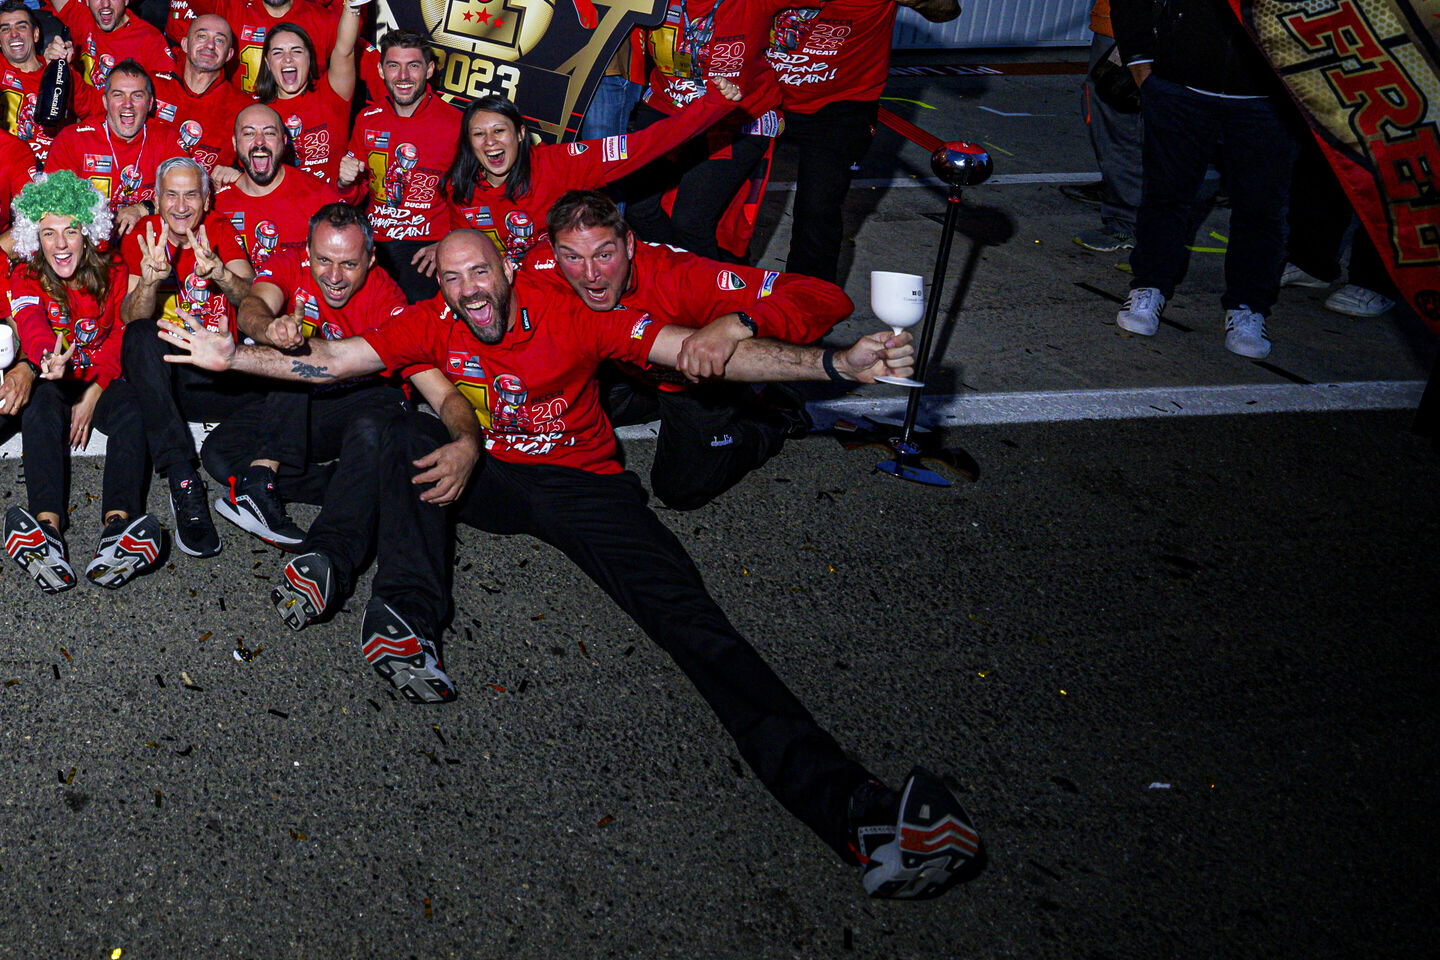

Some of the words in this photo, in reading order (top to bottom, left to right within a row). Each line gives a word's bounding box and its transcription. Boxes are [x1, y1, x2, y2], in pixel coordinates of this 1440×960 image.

[811, 23, 852, 38] 20
[712, 41, 746, 59] 20
[805, 36, 846, 50] 23
[802, 48, 838, 56] DUCATI
[709, 56, 745, 72] 23
[779, 67, 839, 86] AGAIN!
[51, 87, 63, 117] Castaldi
[304, 130, 330, 148] 20
[304, 144, 330, 161] 23
[304, 157, 329, 166] DUCATI
[411, 172, 440, 189] 20
[406, 186, 436, 202] 23
[404, 201, 432, 209] DUCATI
[385, 222, 431, 241] AGAIN!
[531, 398, 569, 425] 20
